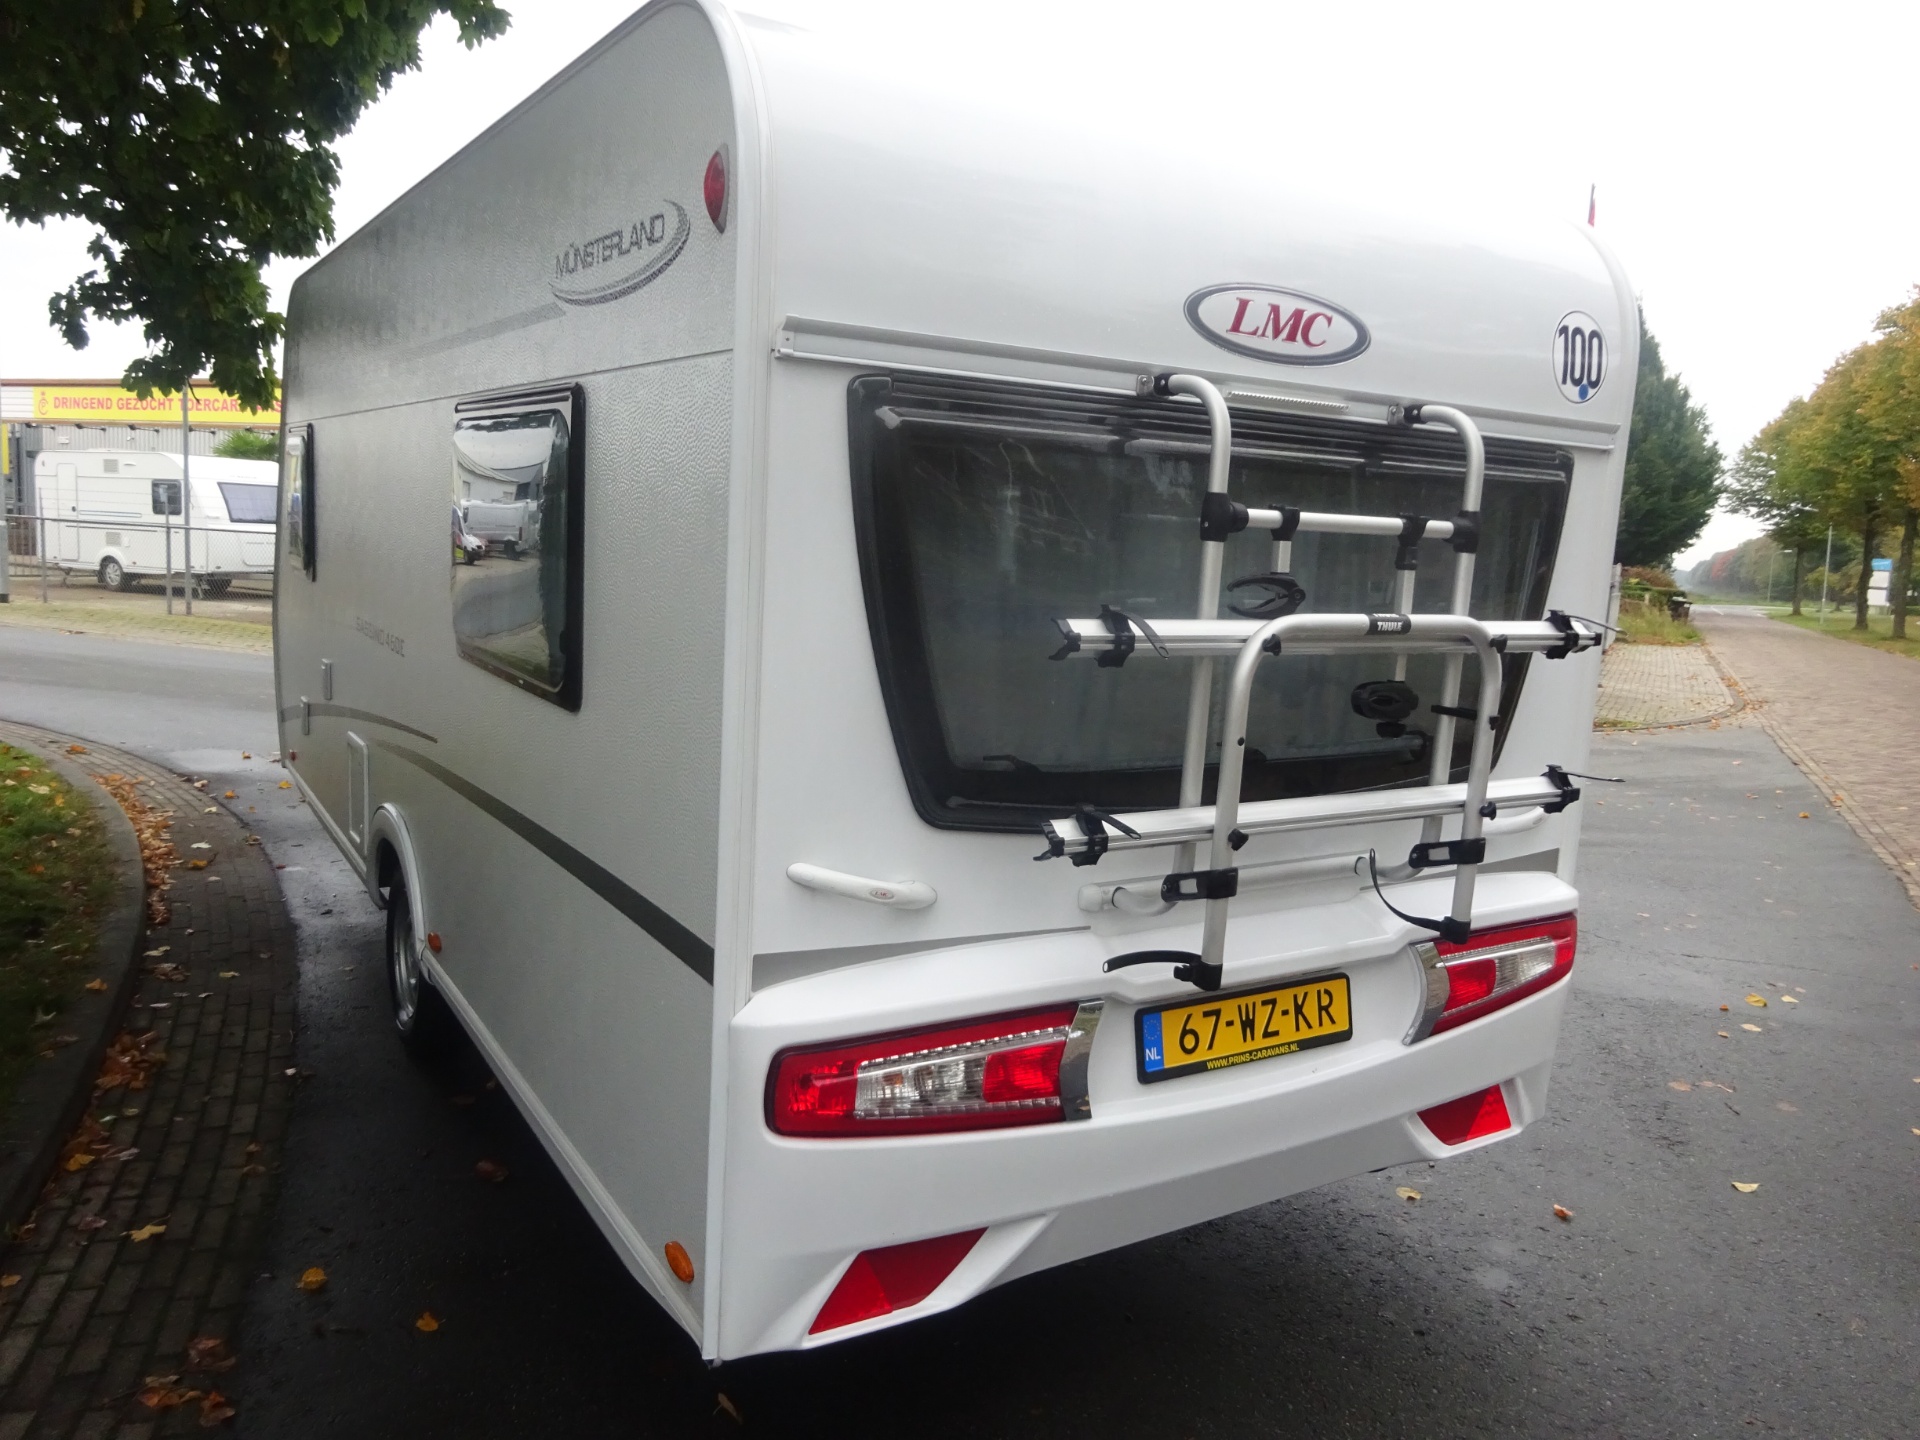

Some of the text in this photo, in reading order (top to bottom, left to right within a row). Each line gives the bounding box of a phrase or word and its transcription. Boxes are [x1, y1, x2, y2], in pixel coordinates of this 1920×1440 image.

[555, 213, 665, 279] MÜNSTERLAND
[1226, 297, 1333, 348] LMC
[1558, 324, 1603, 389] 100
[53, 396, 113, 410] DRINGEND
[116, 398, 174, 411] GEZOCHT
[1377, 621, 1403, 631] THULE
[1178, 988, 1336, 1055] 67-WZ-KR
[1145, 1047, 1161, 1061] NL
[1206, 1042, 1300, 1070] WWW.PRINS-CARAVANS.NL
